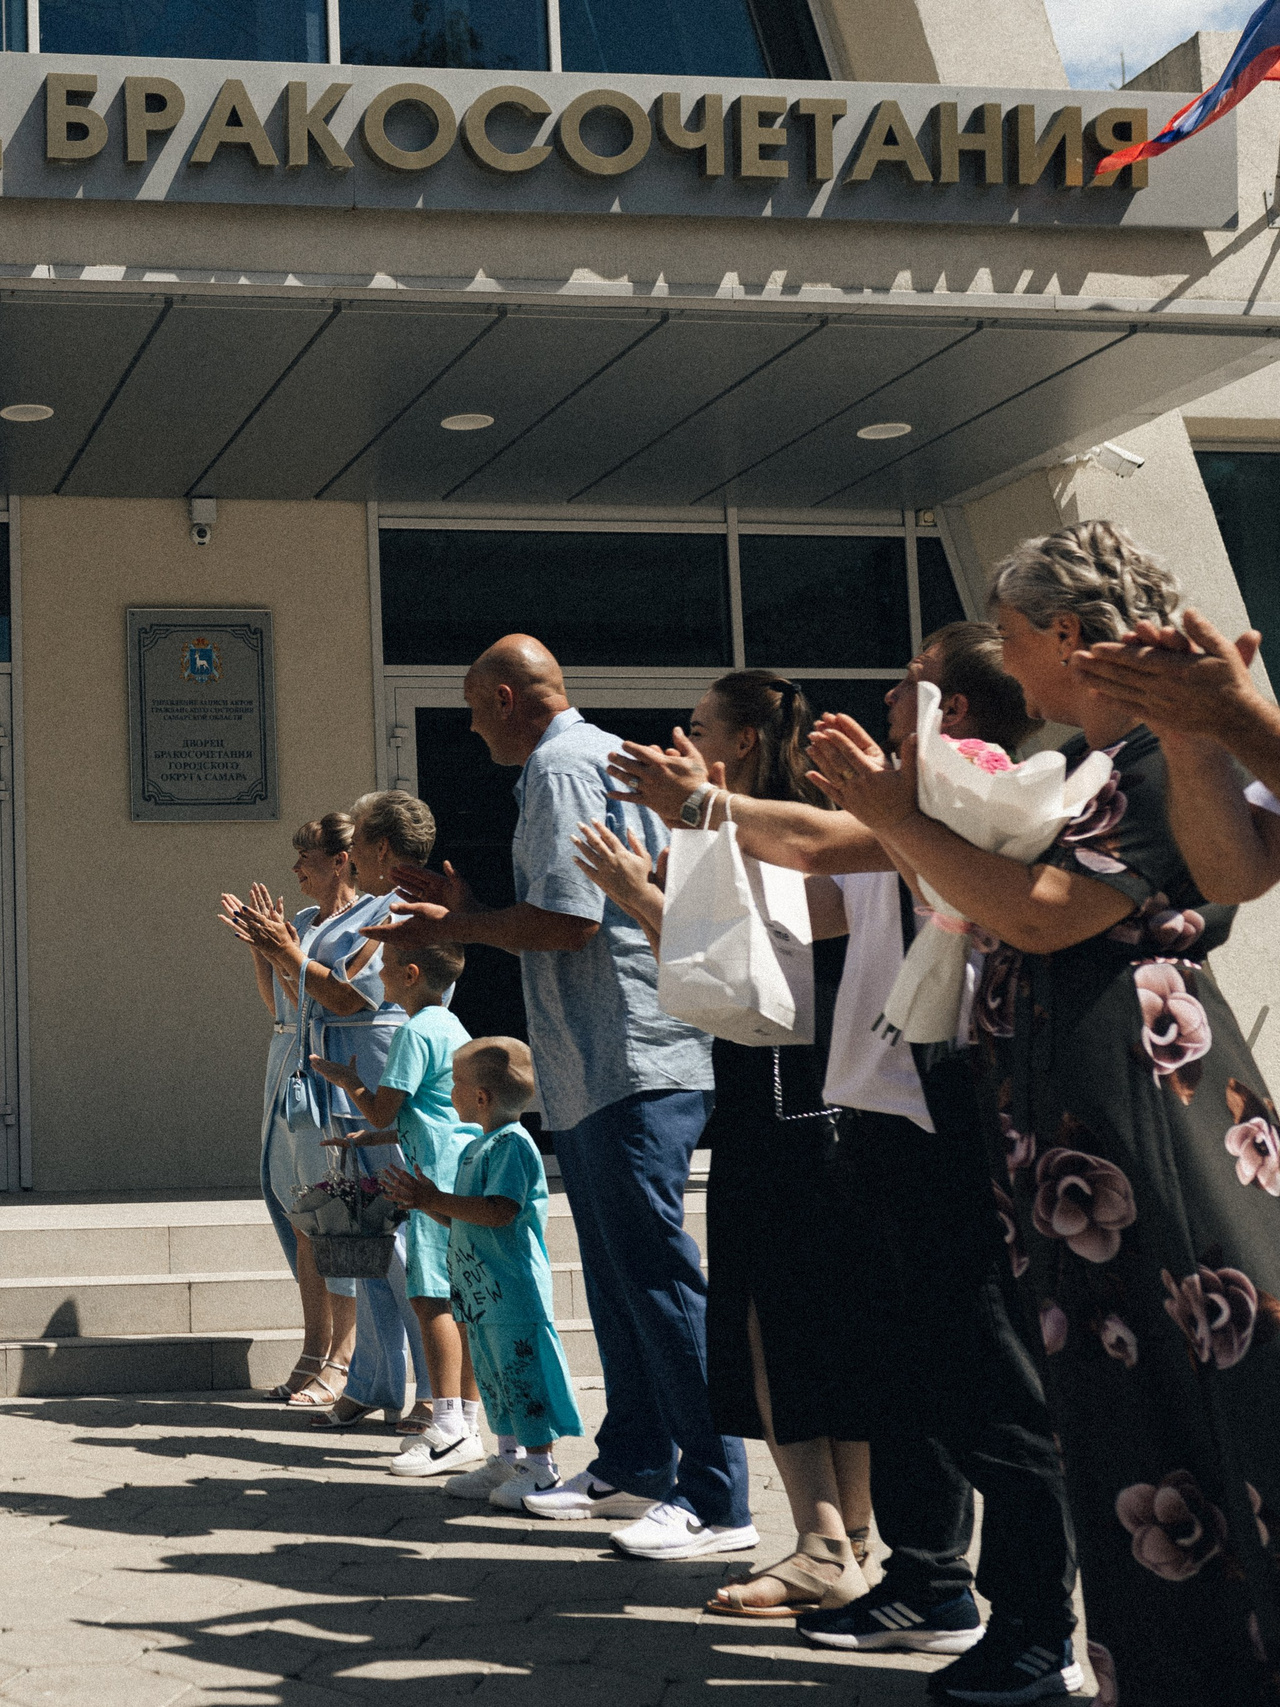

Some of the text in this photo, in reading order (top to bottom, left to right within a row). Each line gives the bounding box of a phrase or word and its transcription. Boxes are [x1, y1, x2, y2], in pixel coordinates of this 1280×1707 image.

[45, 72, 1150, 189] БРАКОСОЧЕТАНИЯ
[182, 739, 225, 749] ДВОРЕЦ
[153, 750, 253, 759] БРАКОСОЧЕТАНИЯ
[168, 761, 240, 771] ГОРОДСКОГО
[160, 773, 248, 782] ОКРУГА САМАРА
